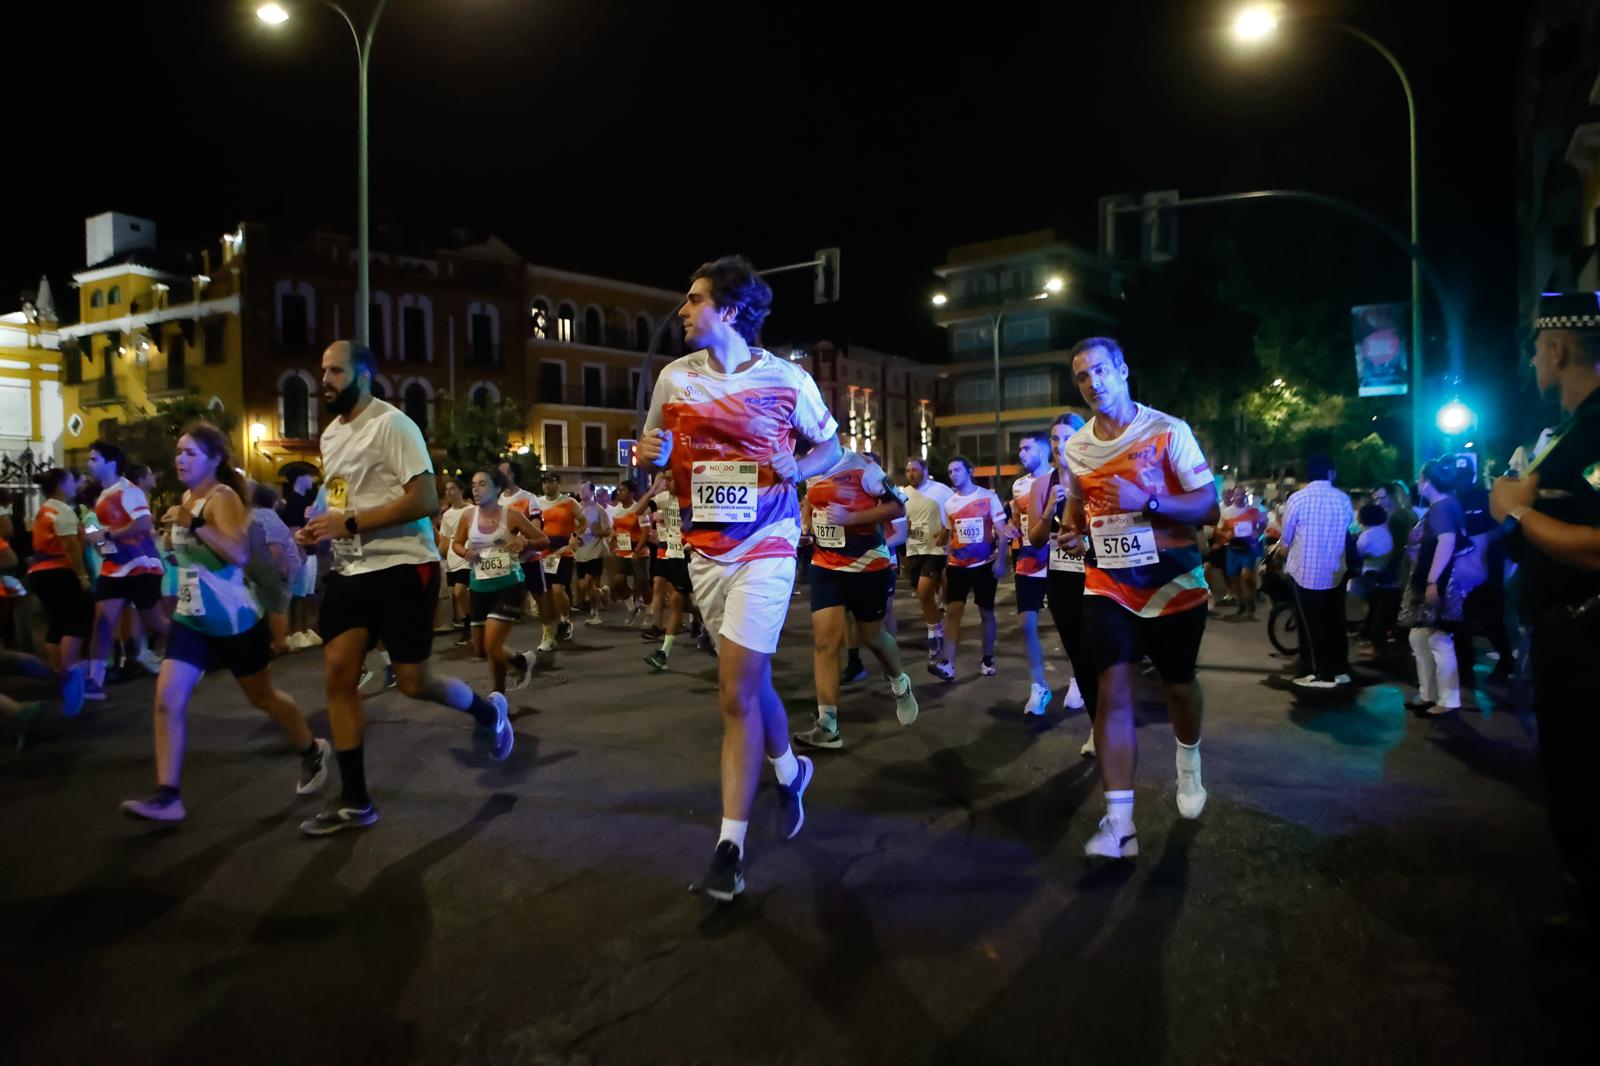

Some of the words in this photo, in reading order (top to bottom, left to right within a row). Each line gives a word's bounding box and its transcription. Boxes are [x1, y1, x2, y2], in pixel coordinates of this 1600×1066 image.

[697, 485, 748, 504] 12662
[816, 525, 836, 538] 7877
[959, 528, 980, 537] 14033
[1103, 535, 1141, 554] 5764
[480, 559, 503, 571] 2063
